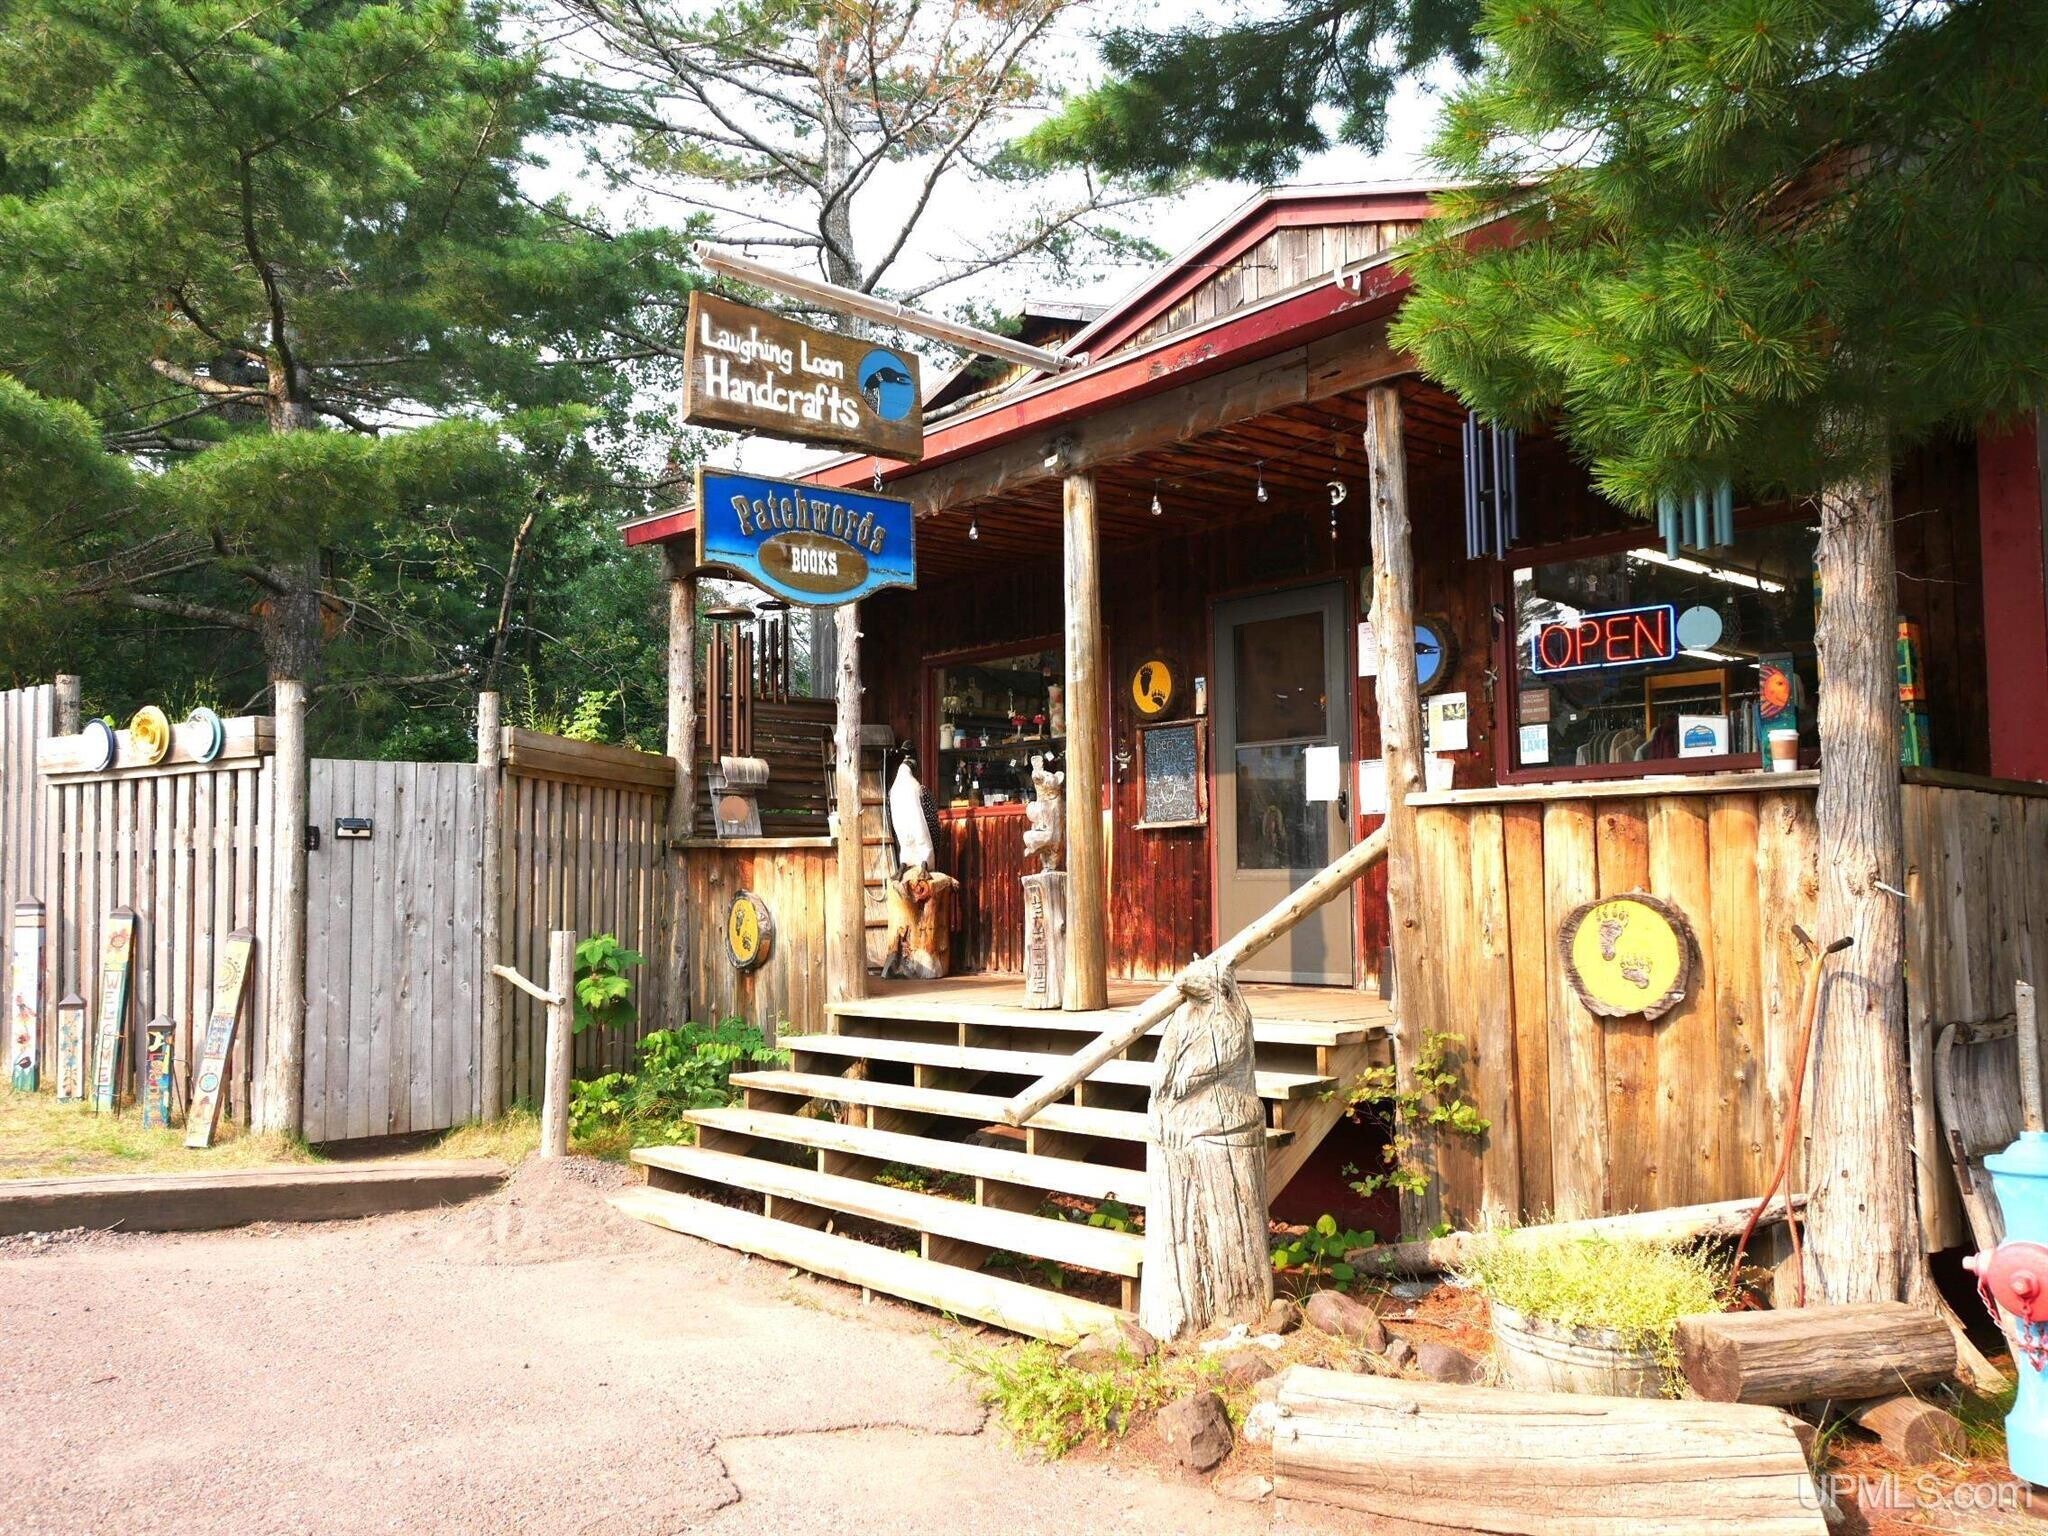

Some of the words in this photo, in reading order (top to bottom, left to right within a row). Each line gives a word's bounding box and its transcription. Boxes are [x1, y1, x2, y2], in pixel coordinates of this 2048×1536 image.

[701, 312, 793, 375] Laughing
[800, 339, 844, 380] Loon
[703, 354, 860, 429] Handcrafts
[731, 488, 886, 555] Patchwords
[791, 546, 838, 577] BOOKS
[1540, 610, 1664, 668] OPEN
[98, 973, 119, 1083] WELCOME
